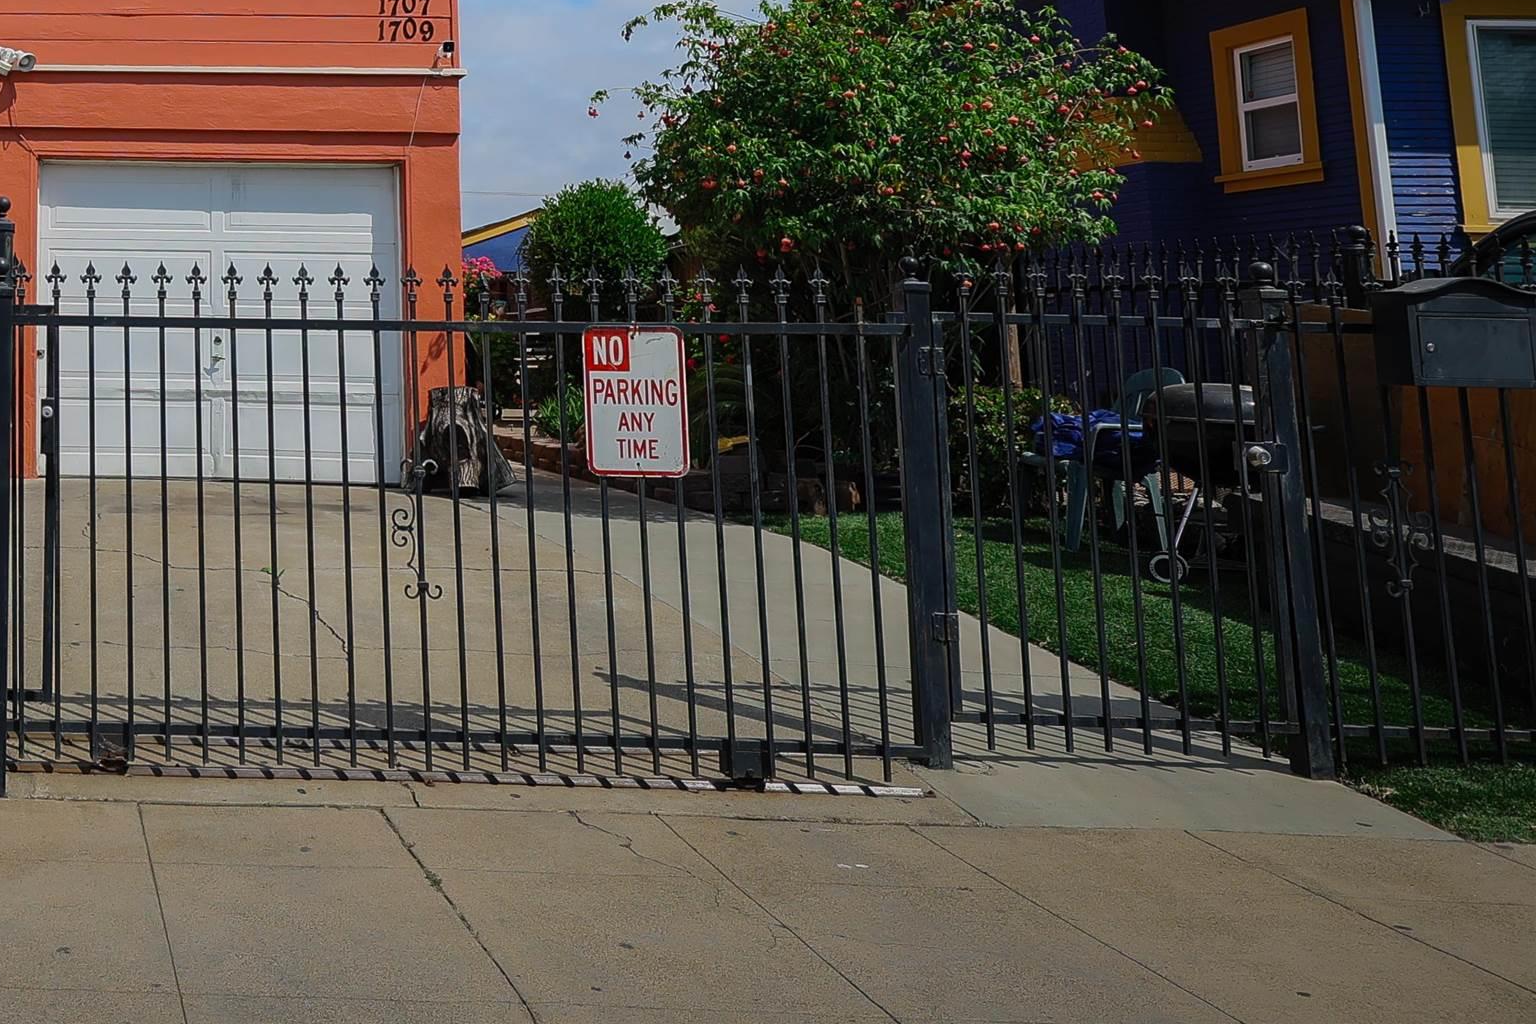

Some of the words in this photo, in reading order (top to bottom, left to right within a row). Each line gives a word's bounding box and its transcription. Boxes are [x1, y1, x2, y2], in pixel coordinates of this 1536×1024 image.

[378, 17, 434, 41] 1709
[592, 336, 624, 366] NO
[593, 378, 678, 406] PARKING
[618, 412, 655, 432] ANY
[616, 438, 659, 460] TIME
